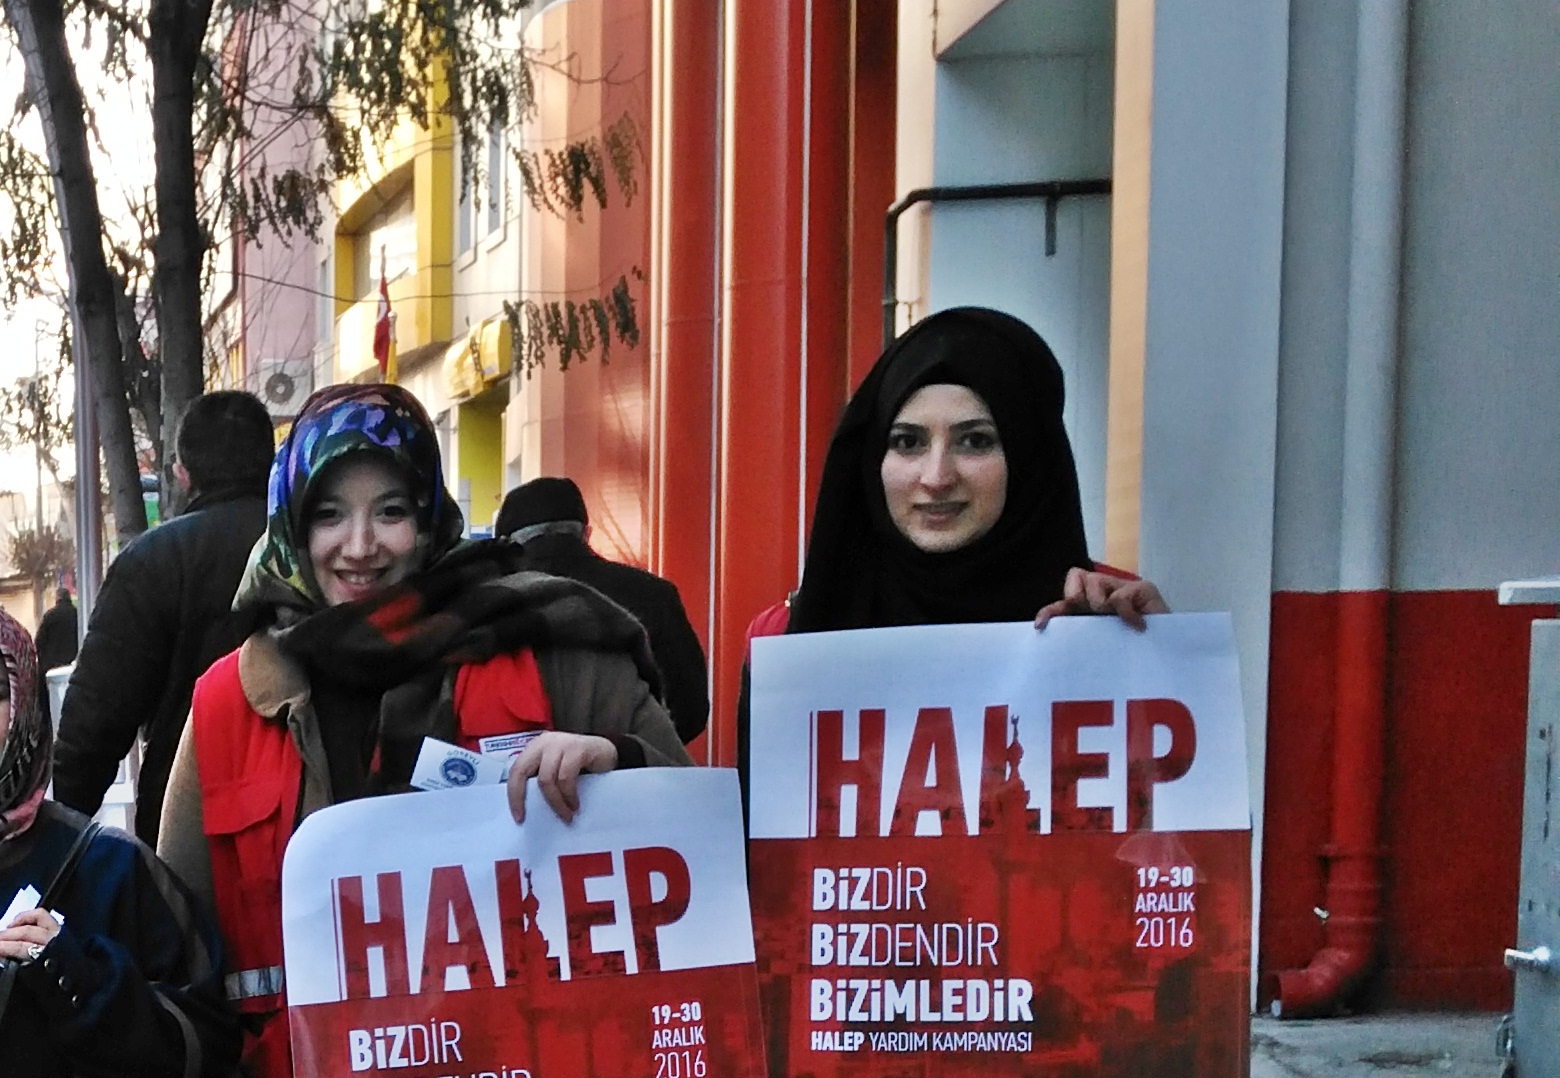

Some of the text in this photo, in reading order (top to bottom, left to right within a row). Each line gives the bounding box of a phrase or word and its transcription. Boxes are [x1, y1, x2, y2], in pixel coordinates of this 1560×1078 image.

[816, 698, 1198, 837] HALEP
[1137, 865, 1195, 888] 19-30
[1135, 891, 1196, 914] ARALIK
[337, 845, 692, 1000] HALEP
[1135, 917, 1194, 949] 2016
[652, 1001, 702, 1025] 19-30
[652, 1026, 706, 1050] ARALIK
[811, 1031, 1032, 1052] HALEP YARDIM KAMPANYASI
